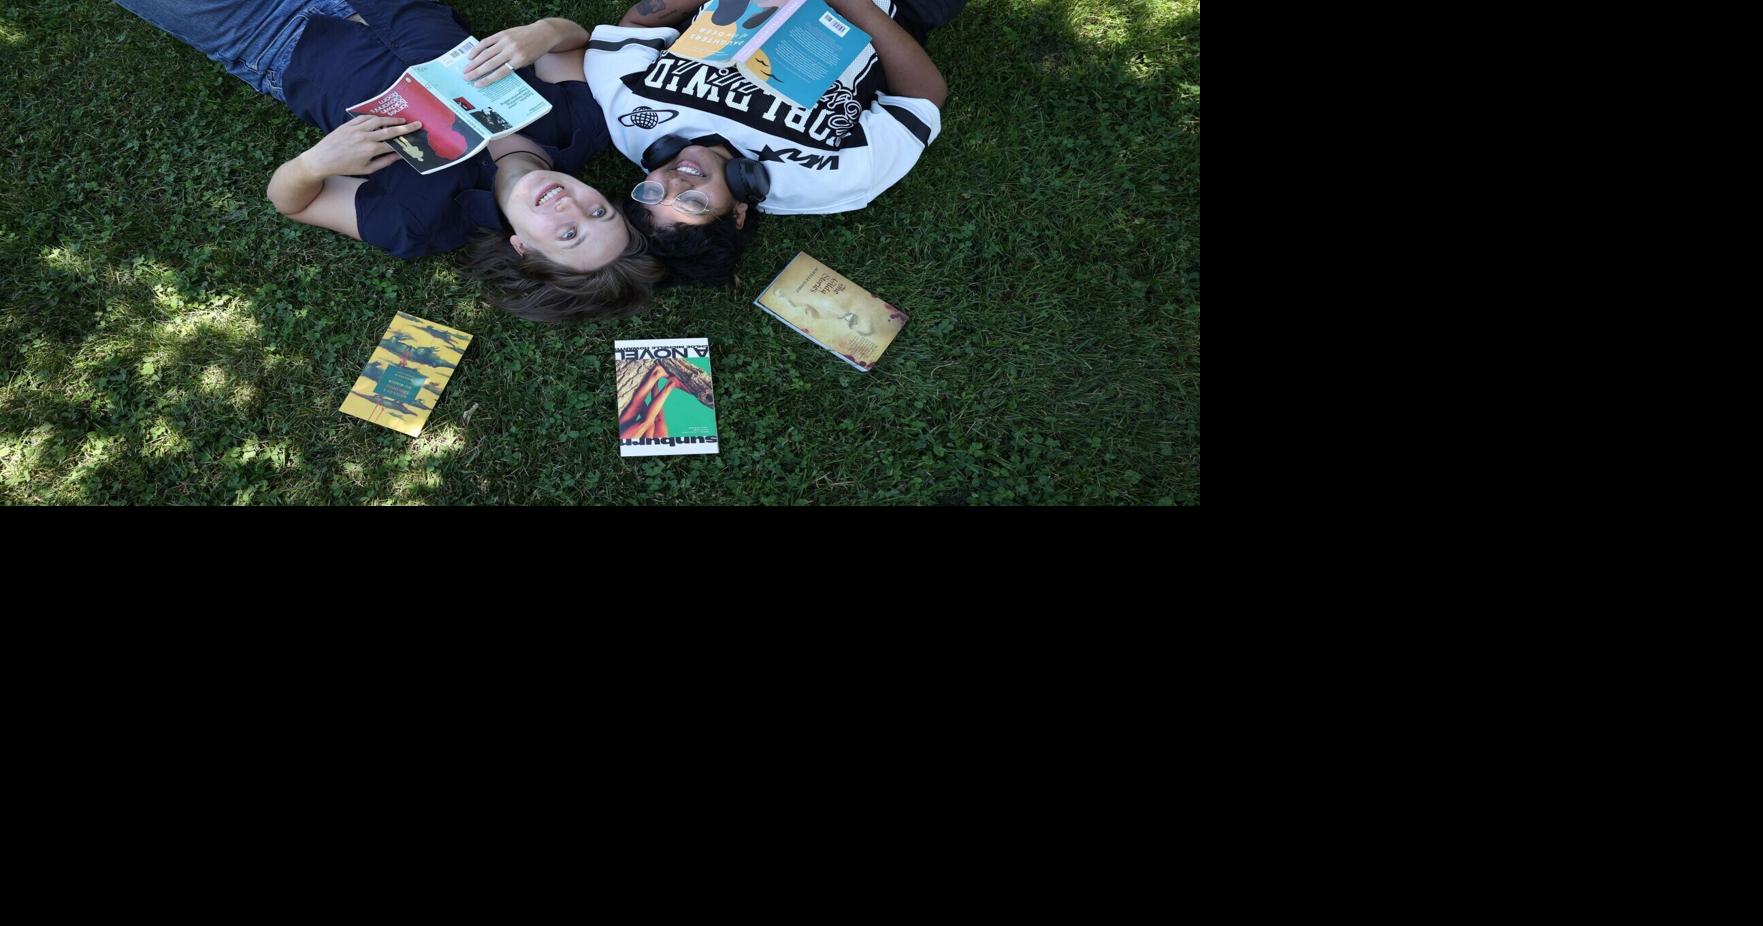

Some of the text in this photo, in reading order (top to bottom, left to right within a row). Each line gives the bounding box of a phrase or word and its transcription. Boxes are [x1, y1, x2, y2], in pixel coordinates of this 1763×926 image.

[616, 346, 709, 360] A NOVEL
[620, 435, 718, 447] sunburn
